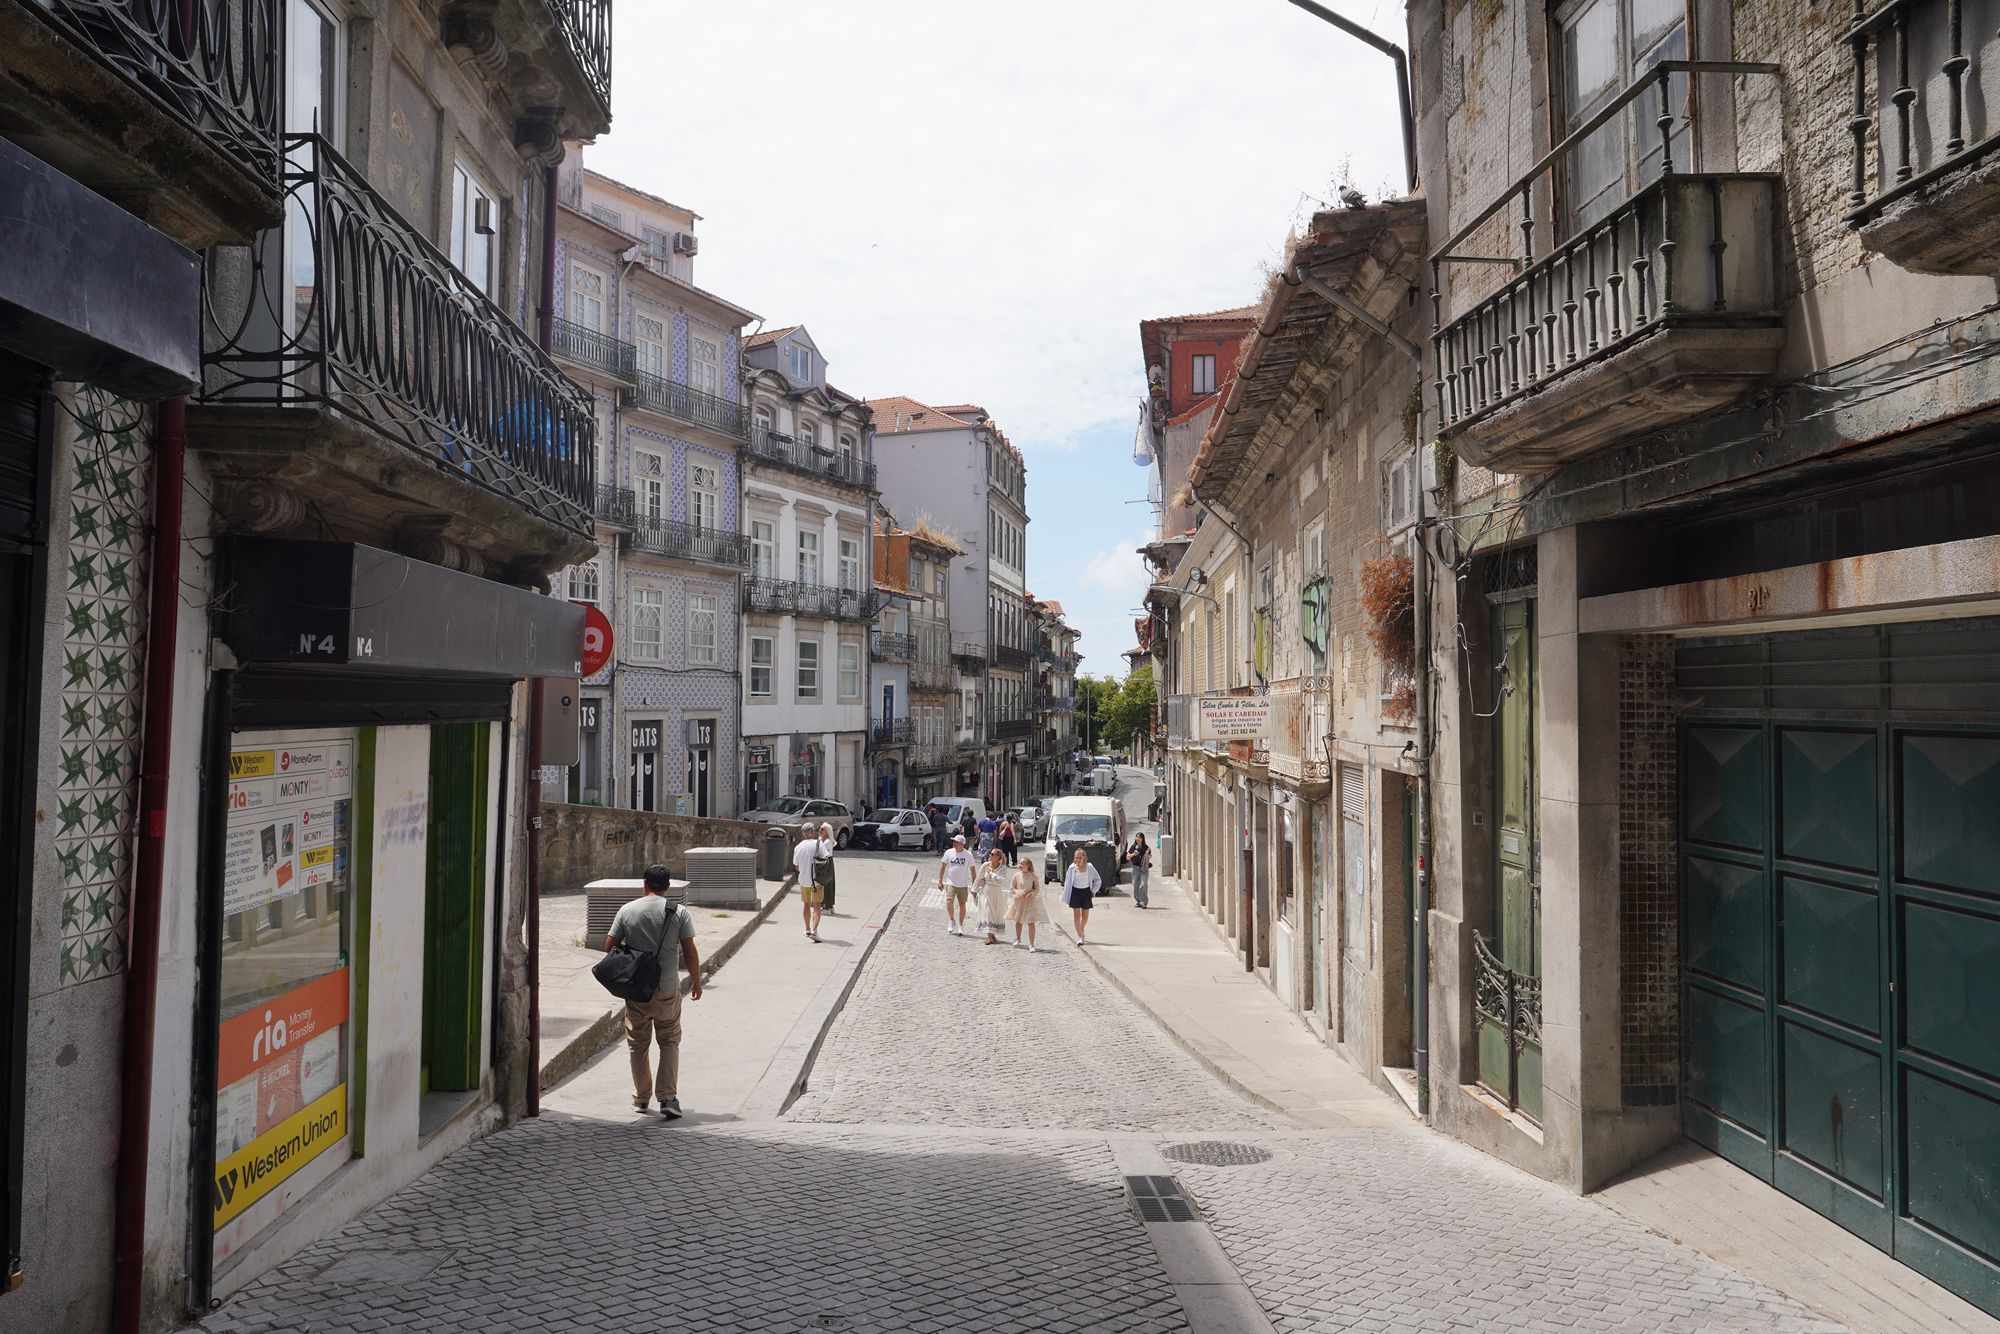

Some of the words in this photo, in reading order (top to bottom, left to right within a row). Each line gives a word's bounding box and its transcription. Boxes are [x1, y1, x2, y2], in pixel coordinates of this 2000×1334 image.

[632, 727, 657, 747] CATS
[243, 754, 265, 765] Western
[291, 753, 322, 767] MoneyGram
[243, 764, 259, 774] Union
[280, 780, 309, 798] MONTY
[289, 1008, 313, 1025] Money
[252, 1009, 287, 1063] ria
[289, 1020, 315, 1042] Transfer
[242, 1135, 300, 1190] Western
[302, 1109, 338, 1148] Union
